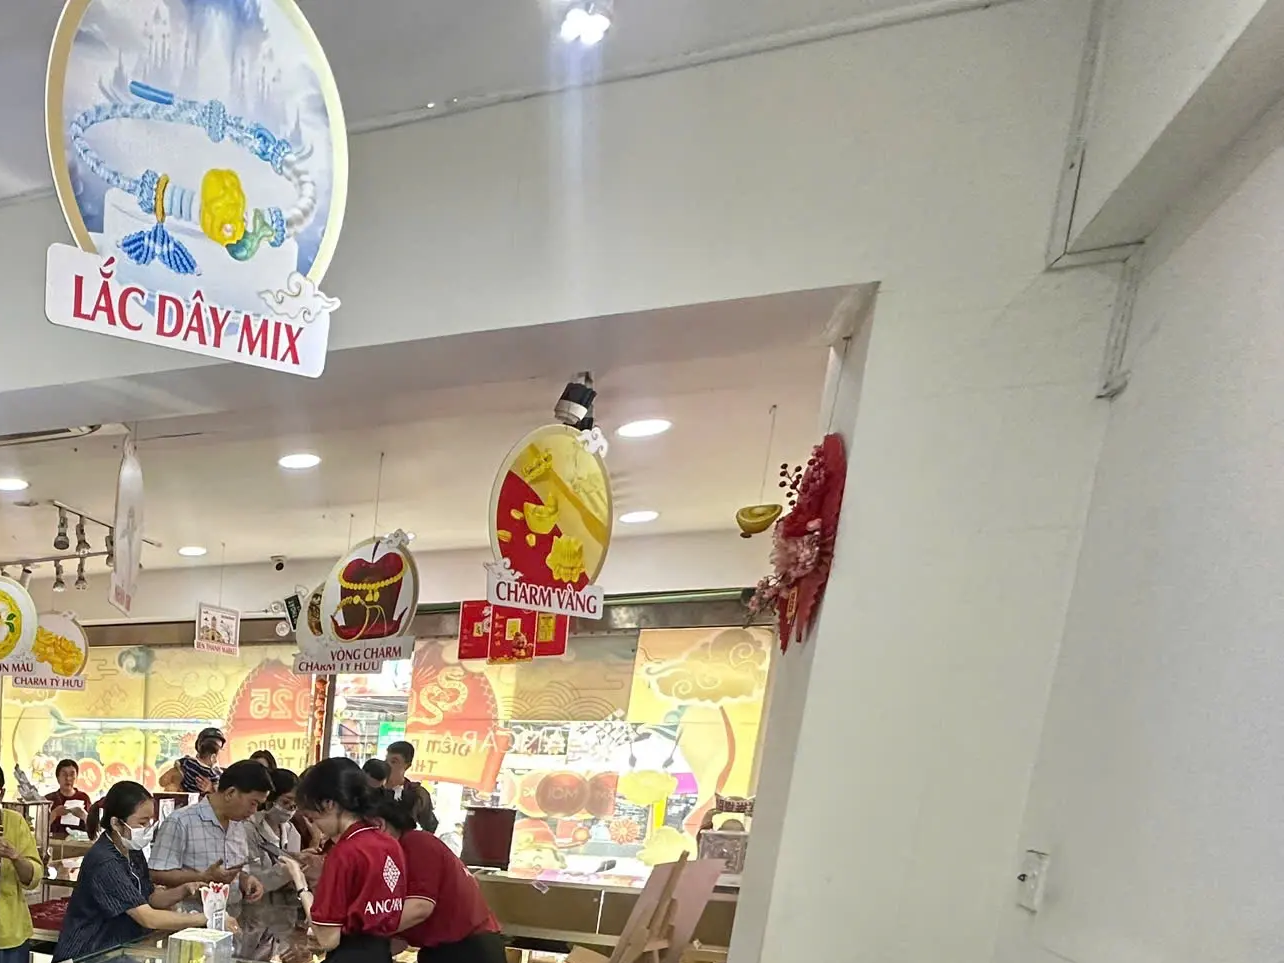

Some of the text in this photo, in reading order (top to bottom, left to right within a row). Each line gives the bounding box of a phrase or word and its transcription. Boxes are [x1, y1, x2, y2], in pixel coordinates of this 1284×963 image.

[73, 257, 304, 365] LẮC DÂY MIX
[496, 581, 597, 614] CHARM VÀNG
[330, 646, 402, 661] VÒNG CHARM
[14, 676, 47, 687] CHARM
